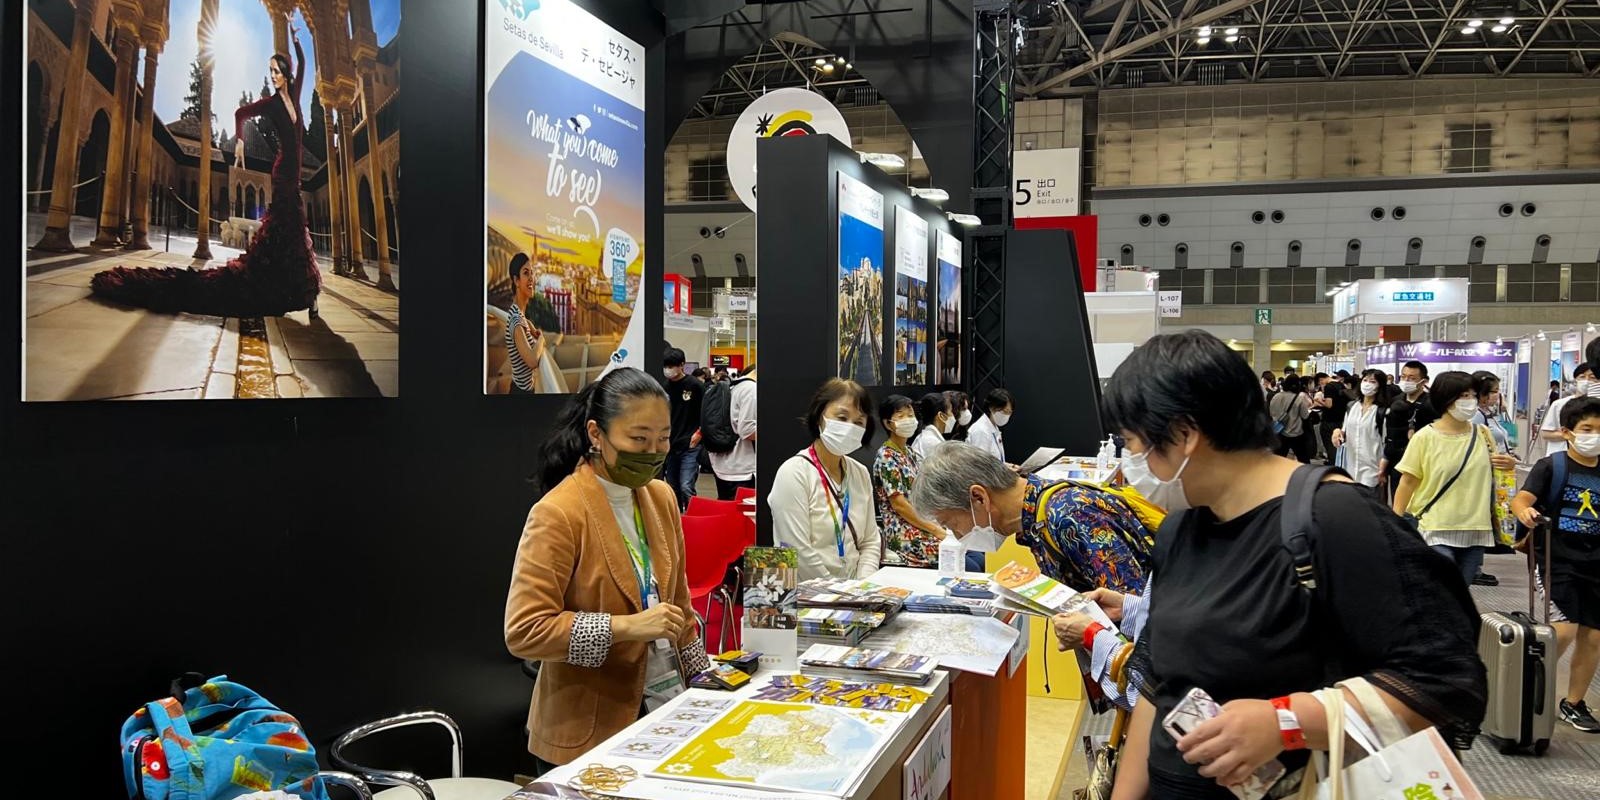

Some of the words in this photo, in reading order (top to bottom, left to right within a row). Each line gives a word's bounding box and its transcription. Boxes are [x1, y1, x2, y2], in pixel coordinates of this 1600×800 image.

[503, 17, 527, 40] Setas
[528, 31, 538, 47] de
[539, 36, 565, 60] Sevilla
[526, 109, 563, 145] What
[562, 131, 587, 159] you
[587, 139, 619, 168] come
[546, 145, 568, 198] to
[1036, 178, 1056, 188] 出口
[1015, 179, 1031, 206] 5
[1036, 190, 1051, 198] Exit
